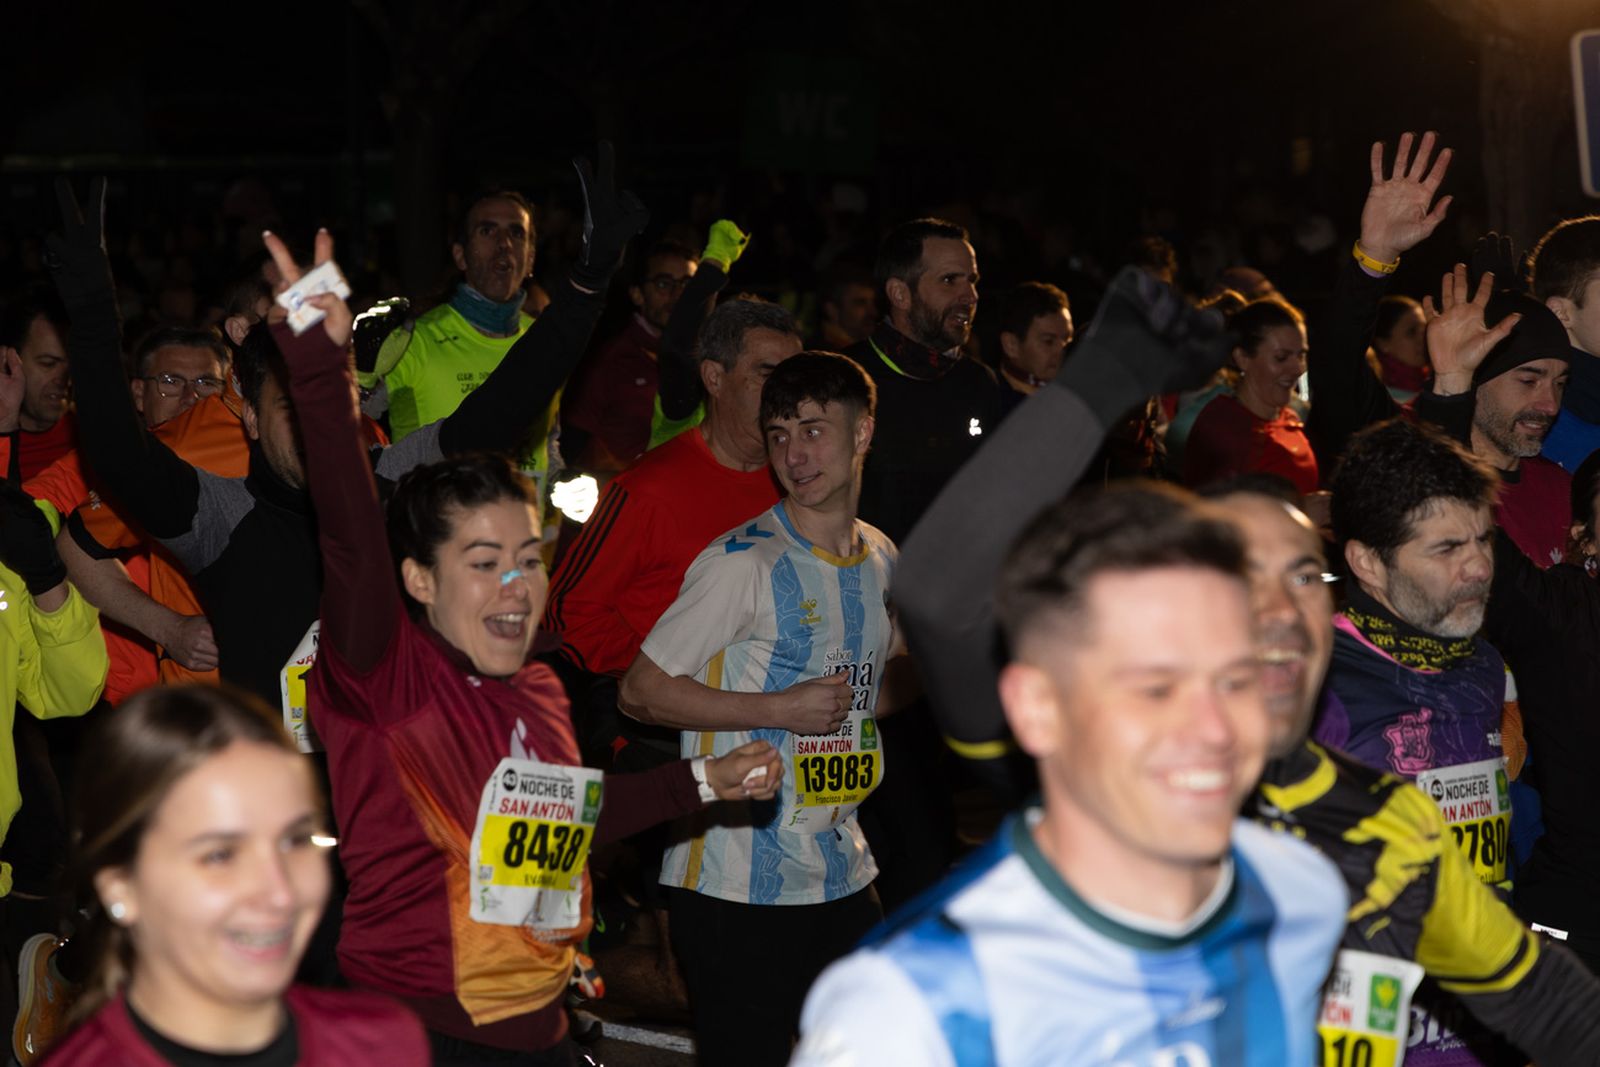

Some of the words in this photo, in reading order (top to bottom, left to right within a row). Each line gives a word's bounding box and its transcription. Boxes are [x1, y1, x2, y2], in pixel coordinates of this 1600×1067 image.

[777, 90, 849, 143] WC
[825, 648, 852, 661] sabor
[841, 725, 853, 736] DE
[798, 741, 818, 754] SAN
[820, 736, 853, 753] ANTÓN
[799, 753, 874, 793] 13983
[519, 779, 559, 798] NOCHE
[560, 783, 575, 800] DE
[815, 794, 841, 804] Francisco
[1446, 782, 1478, 801] NOCHE
[1478, 779, 1490, 796] DE
[499, 797, 530, 816] SAN
[531, 798, 575, 821] ANTÓN
[1442, 804, 1457, 823] AN
[1459, 796, 1493, 820] ANTÓN
[503, 821, 585, 872] 8438
